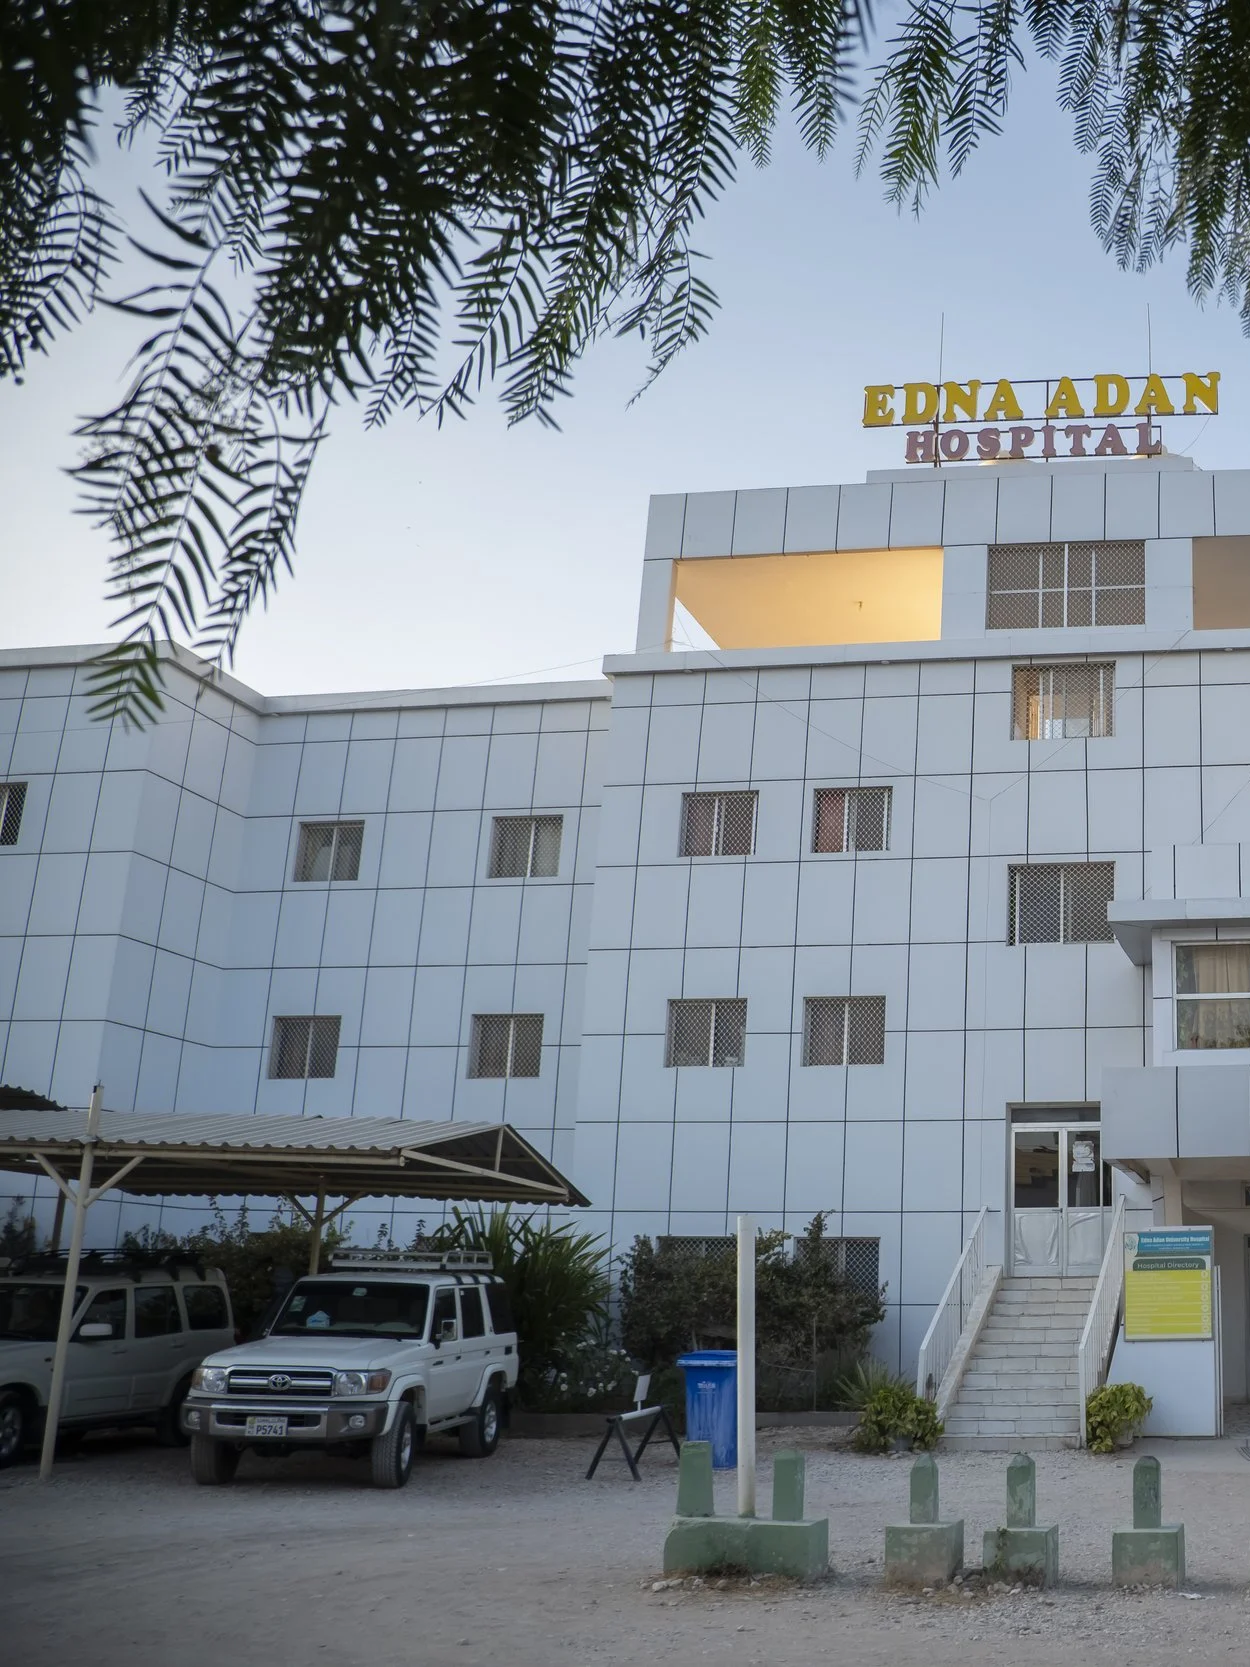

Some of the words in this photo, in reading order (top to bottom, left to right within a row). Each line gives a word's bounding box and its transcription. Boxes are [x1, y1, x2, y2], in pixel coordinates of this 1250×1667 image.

[863, 379, 1024, 427] EDNA
[1044, 371, 1221, 418] ADAN
[905, 422, 1161, 463] HOSPITAL
